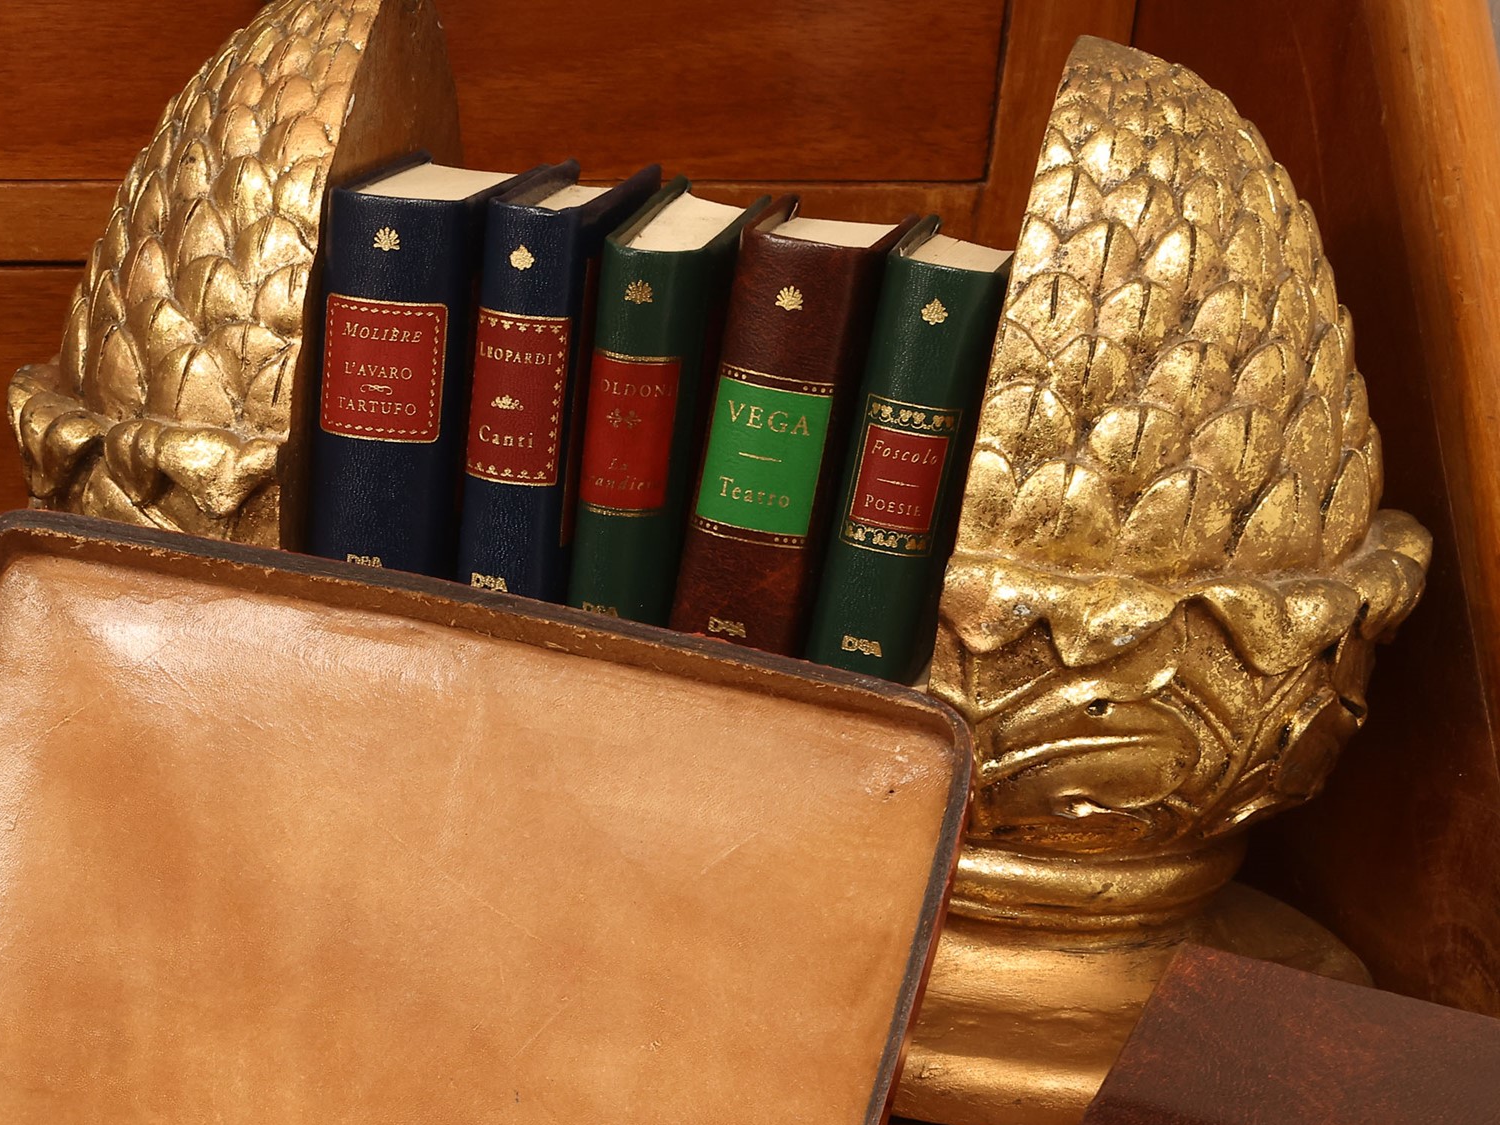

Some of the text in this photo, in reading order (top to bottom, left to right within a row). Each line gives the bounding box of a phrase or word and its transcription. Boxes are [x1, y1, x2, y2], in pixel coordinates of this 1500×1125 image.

[342, 321, 422, 343] MOLIÈRE
[479, 341, 552, 366] LEOPARDI
[344, 361, 413, 381] L'AVARO
[337, 396, 417, 416] TARTUFO
[728, 399, 811, 437] VEGA
[478, 424, 534, 449] Canti
[871, 439, 938, 465] Foscolo
[718, 475, 791, 509] Teatro
[864, 494, 922, 517] POESIE
